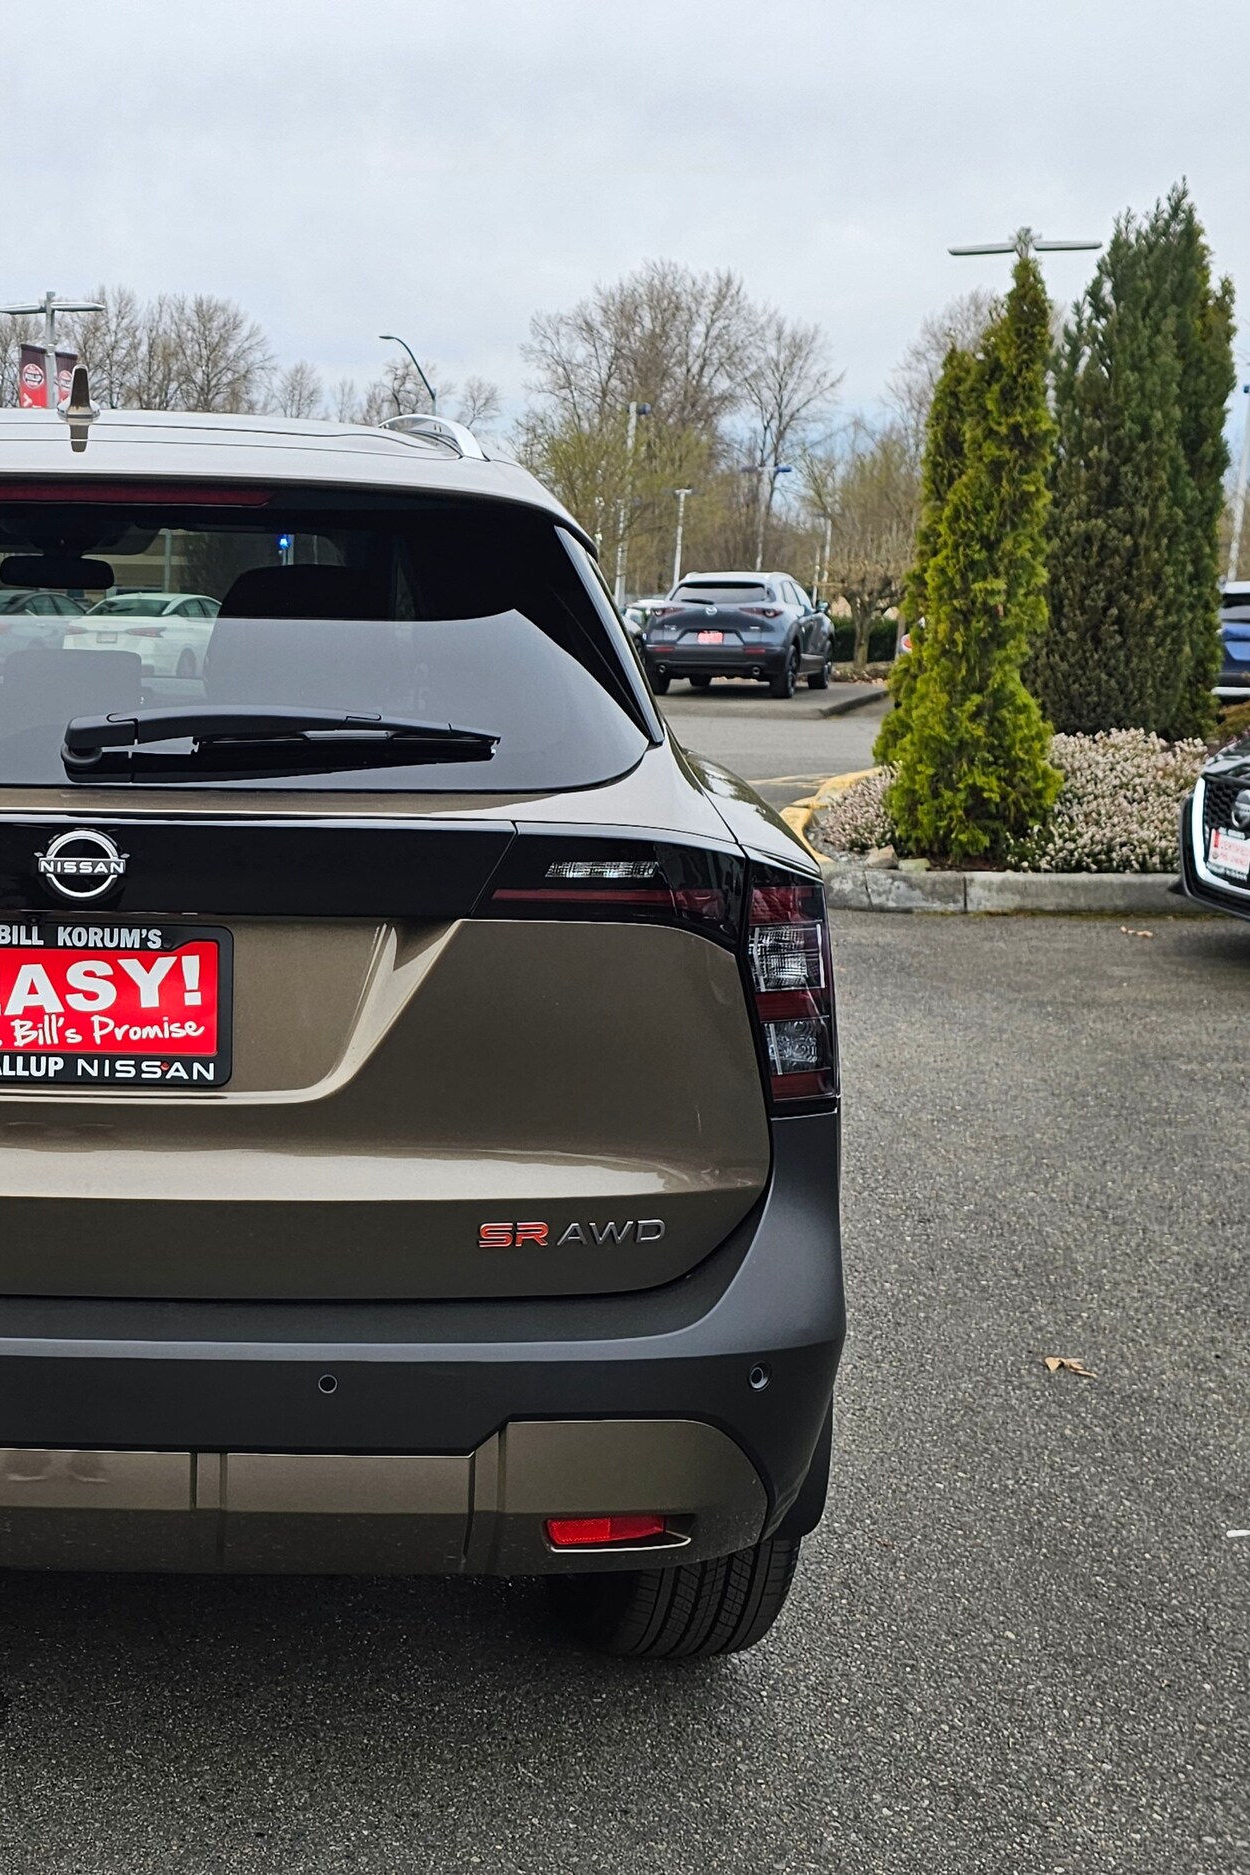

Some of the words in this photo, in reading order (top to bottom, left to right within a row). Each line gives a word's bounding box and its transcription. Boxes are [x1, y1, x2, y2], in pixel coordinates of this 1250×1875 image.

[40, 860, 124, 874] NISSAN
[57, 926, 163, 949] KORUM'S
[11, 1014, 83, 1047] Bill's
[90, 1015, 205, 1045] Promise
[77, 1058, 215, 1081] NISSAN
[478, 1221, 549, 1248] SR
[556, 1218, 666, 1247] AWD
